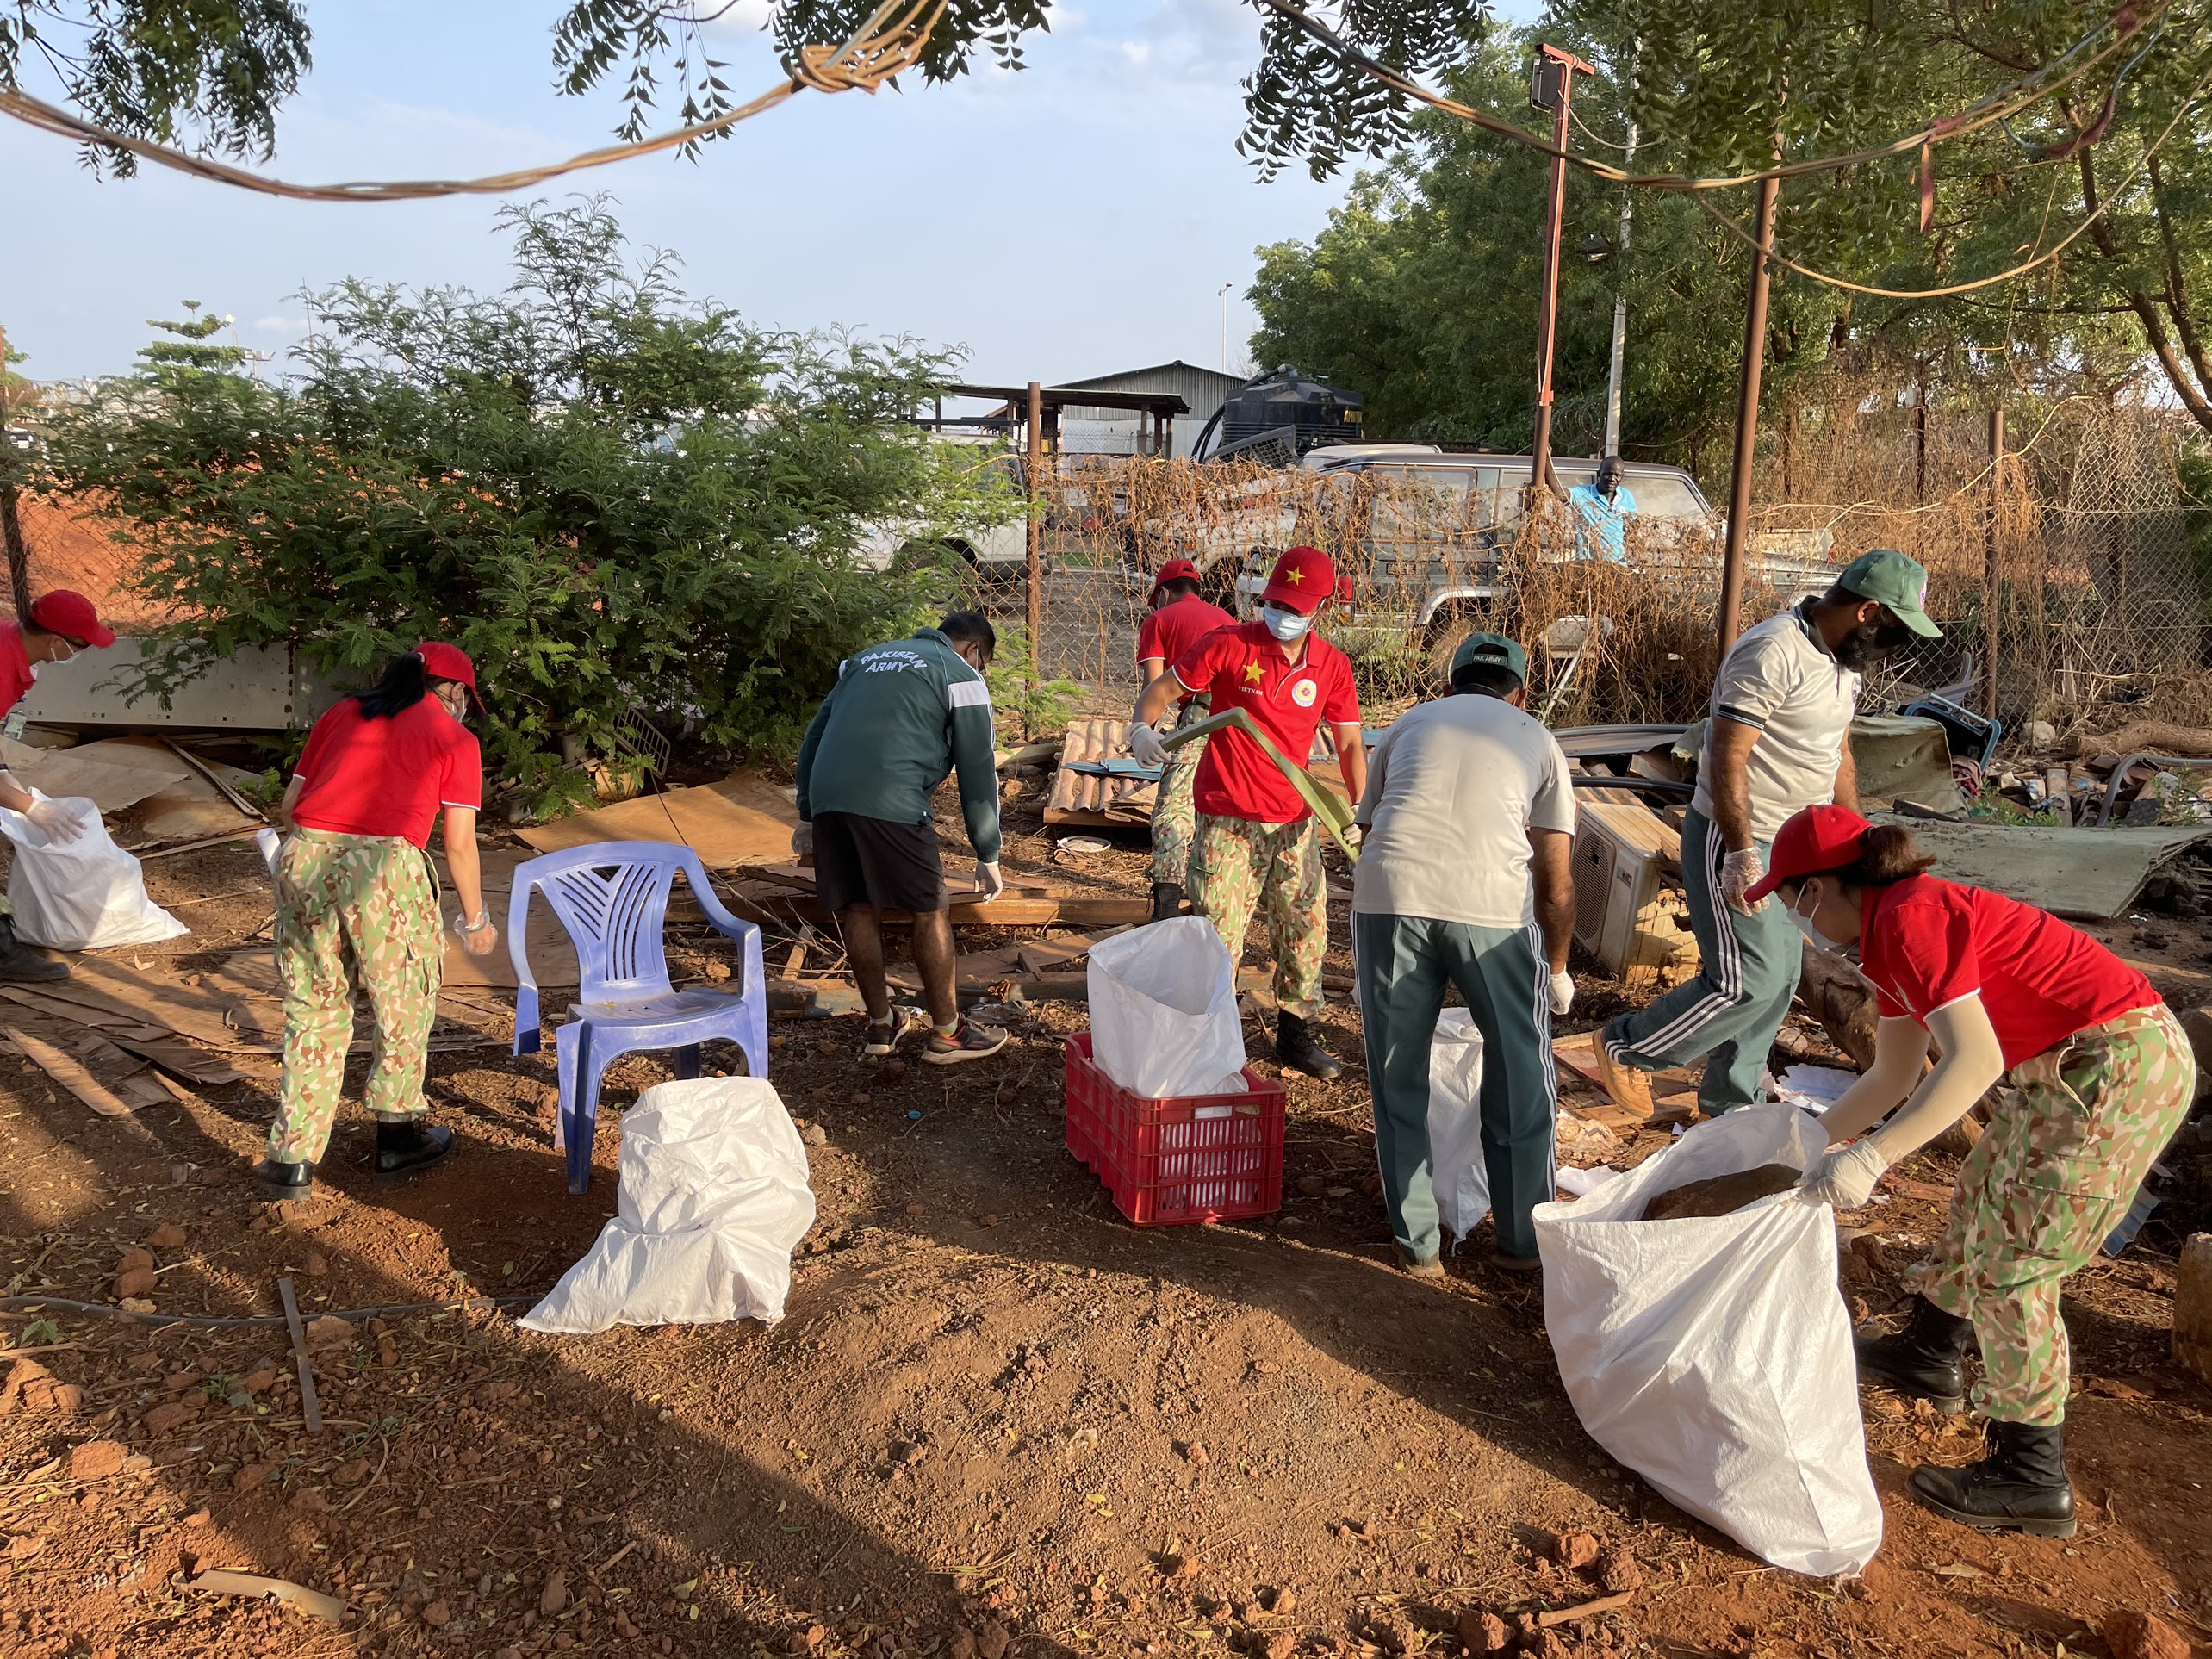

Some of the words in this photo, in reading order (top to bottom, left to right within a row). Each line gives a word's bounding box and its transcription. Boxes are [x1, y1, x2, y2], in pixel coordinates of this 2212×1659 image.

[861, 650, 927, 668] PAKISTAN
[865, 662, 910, 673] ARMY
[1238, 685, 1263, 695] VIETNAM
